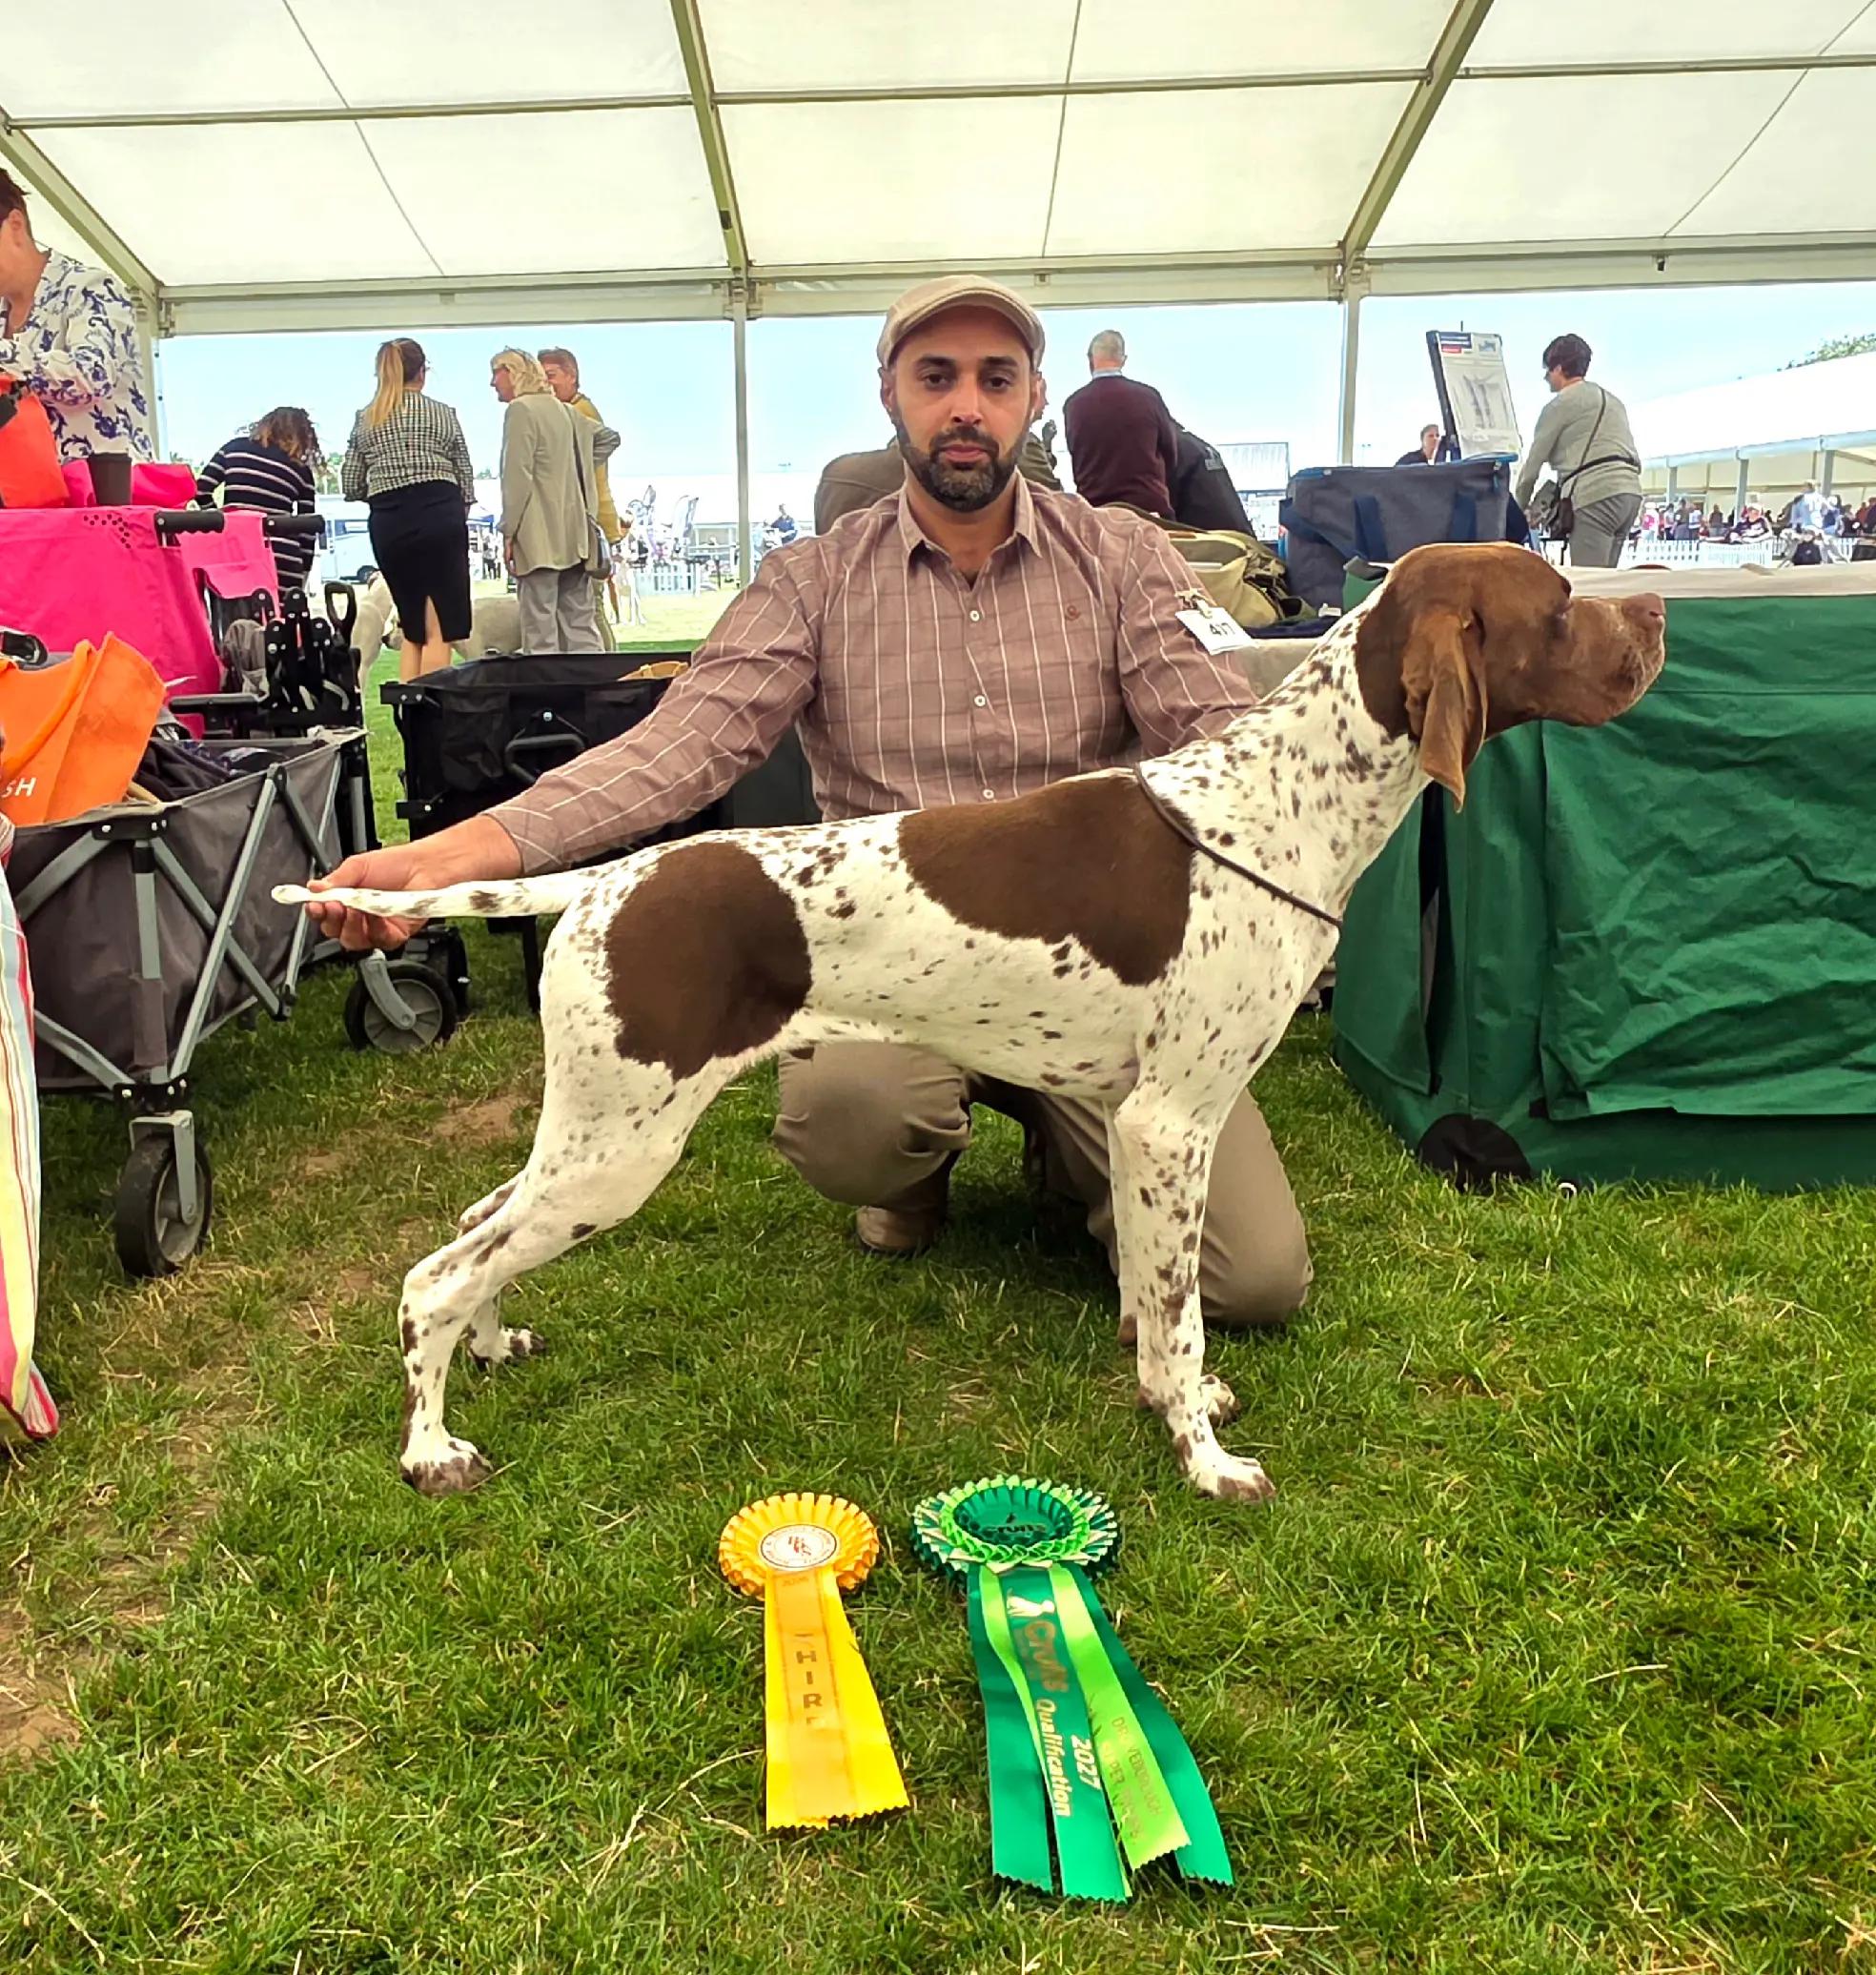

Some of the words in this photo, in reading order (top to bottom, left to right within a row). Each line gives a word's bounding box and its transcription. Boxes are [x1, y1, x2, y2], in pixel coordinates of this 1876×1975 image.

[1035, 1698, 1072, 1818] Qualification
[1071, 1734, 1101, 1791] 2027
[1111, 1716, 1161, 1816] DRVEBOROUGH
